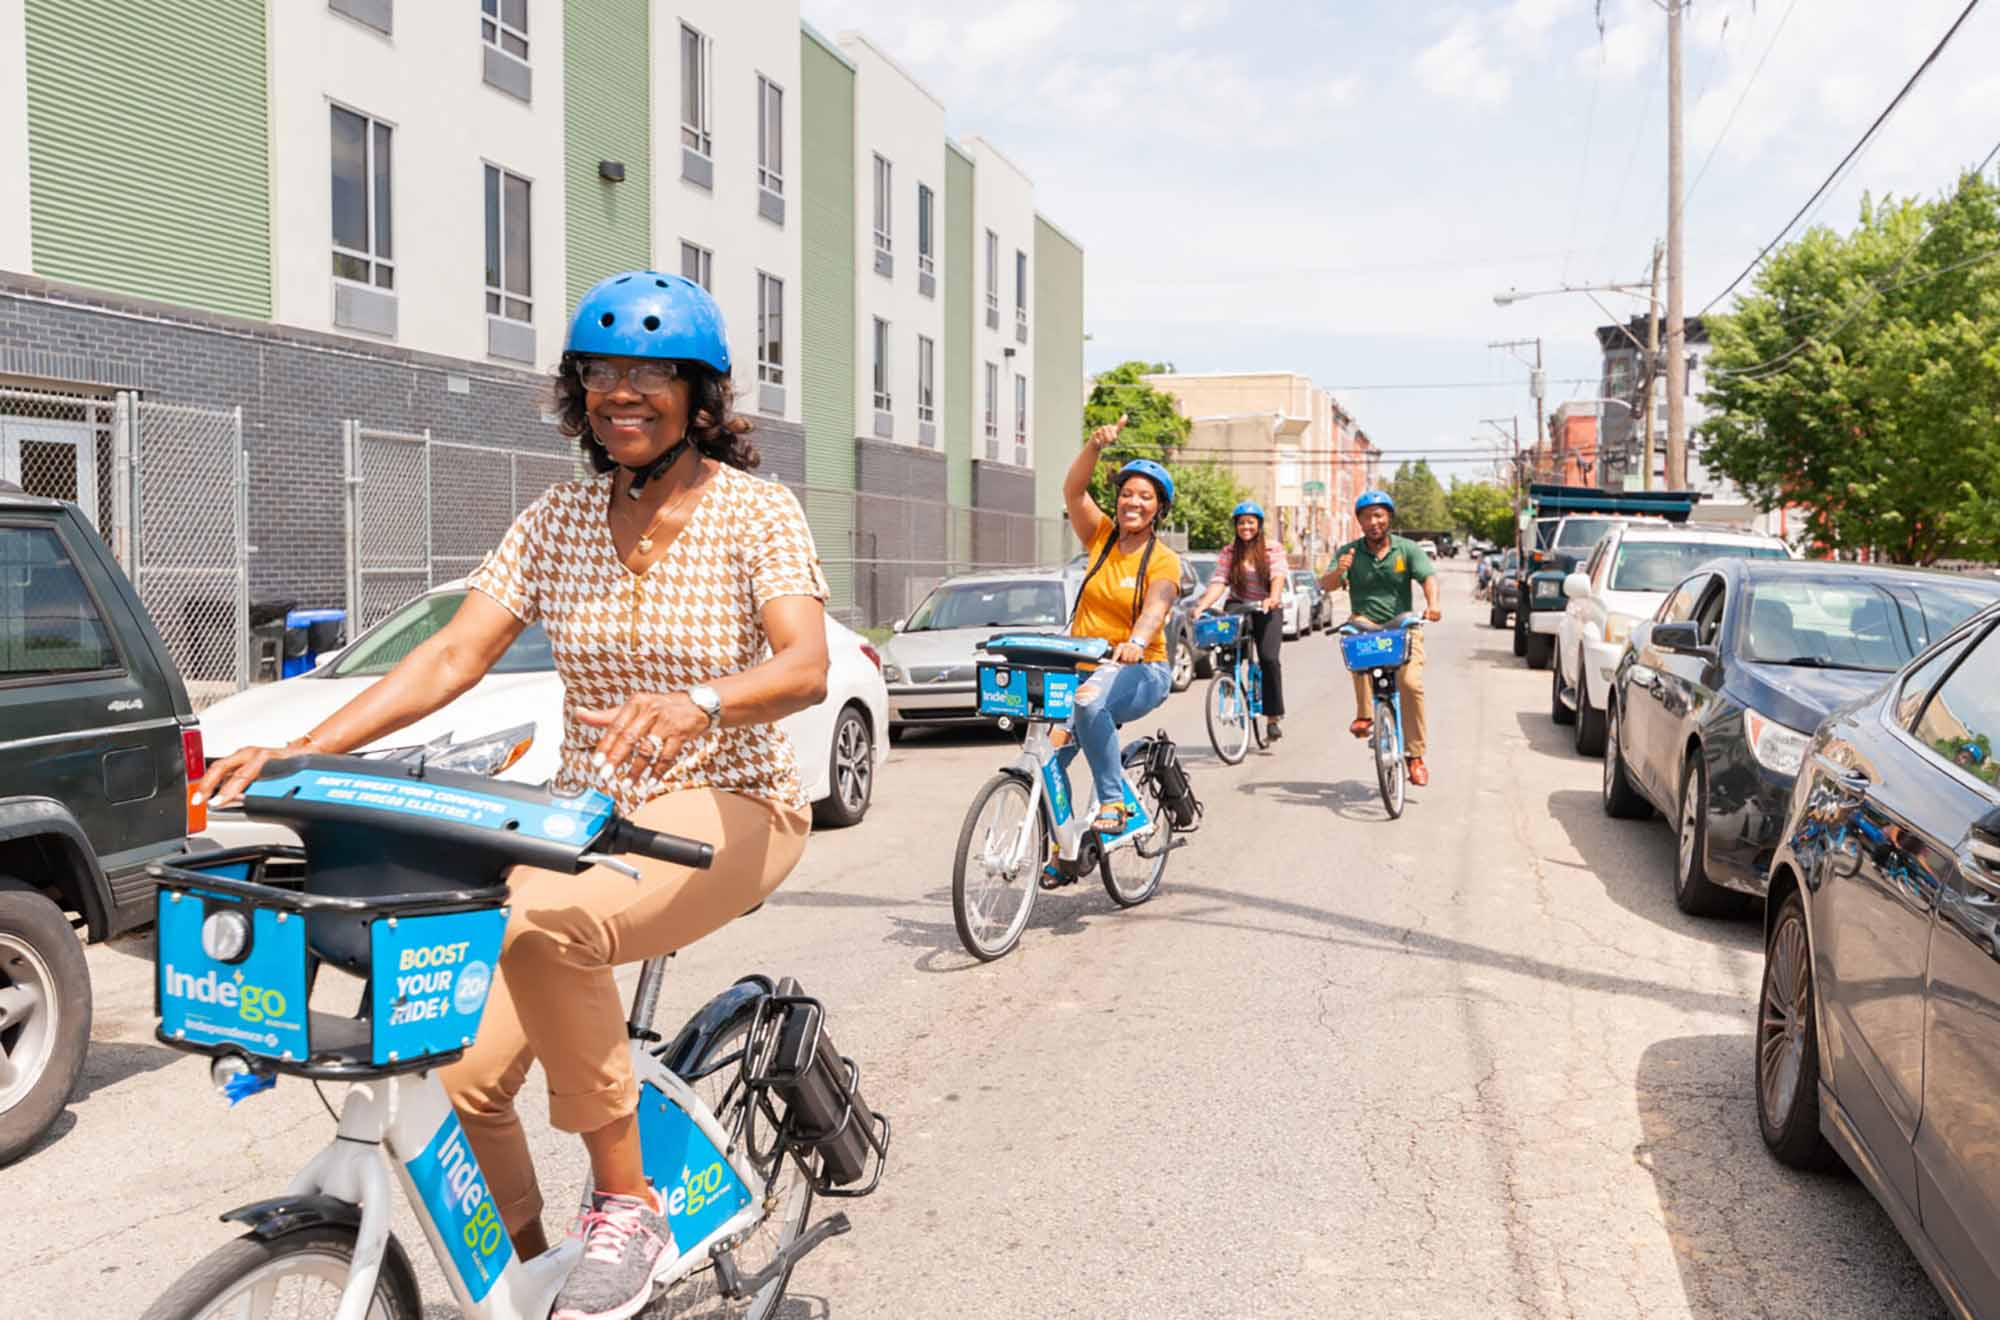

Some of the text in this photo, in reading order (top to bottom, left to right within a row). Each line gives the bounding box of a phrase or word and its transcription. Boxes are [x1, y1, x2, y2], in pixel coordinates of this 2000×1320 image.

[399, 941, 470, 971] BOOST
[165, 963, 286, 1022] Indego
[396, 970, 453, 998] YOUR
[389, 997, 441, 1026] RIDE
[436, 1124, 502, 1256] Indego
[660, 1162, 723, 1216] ego
